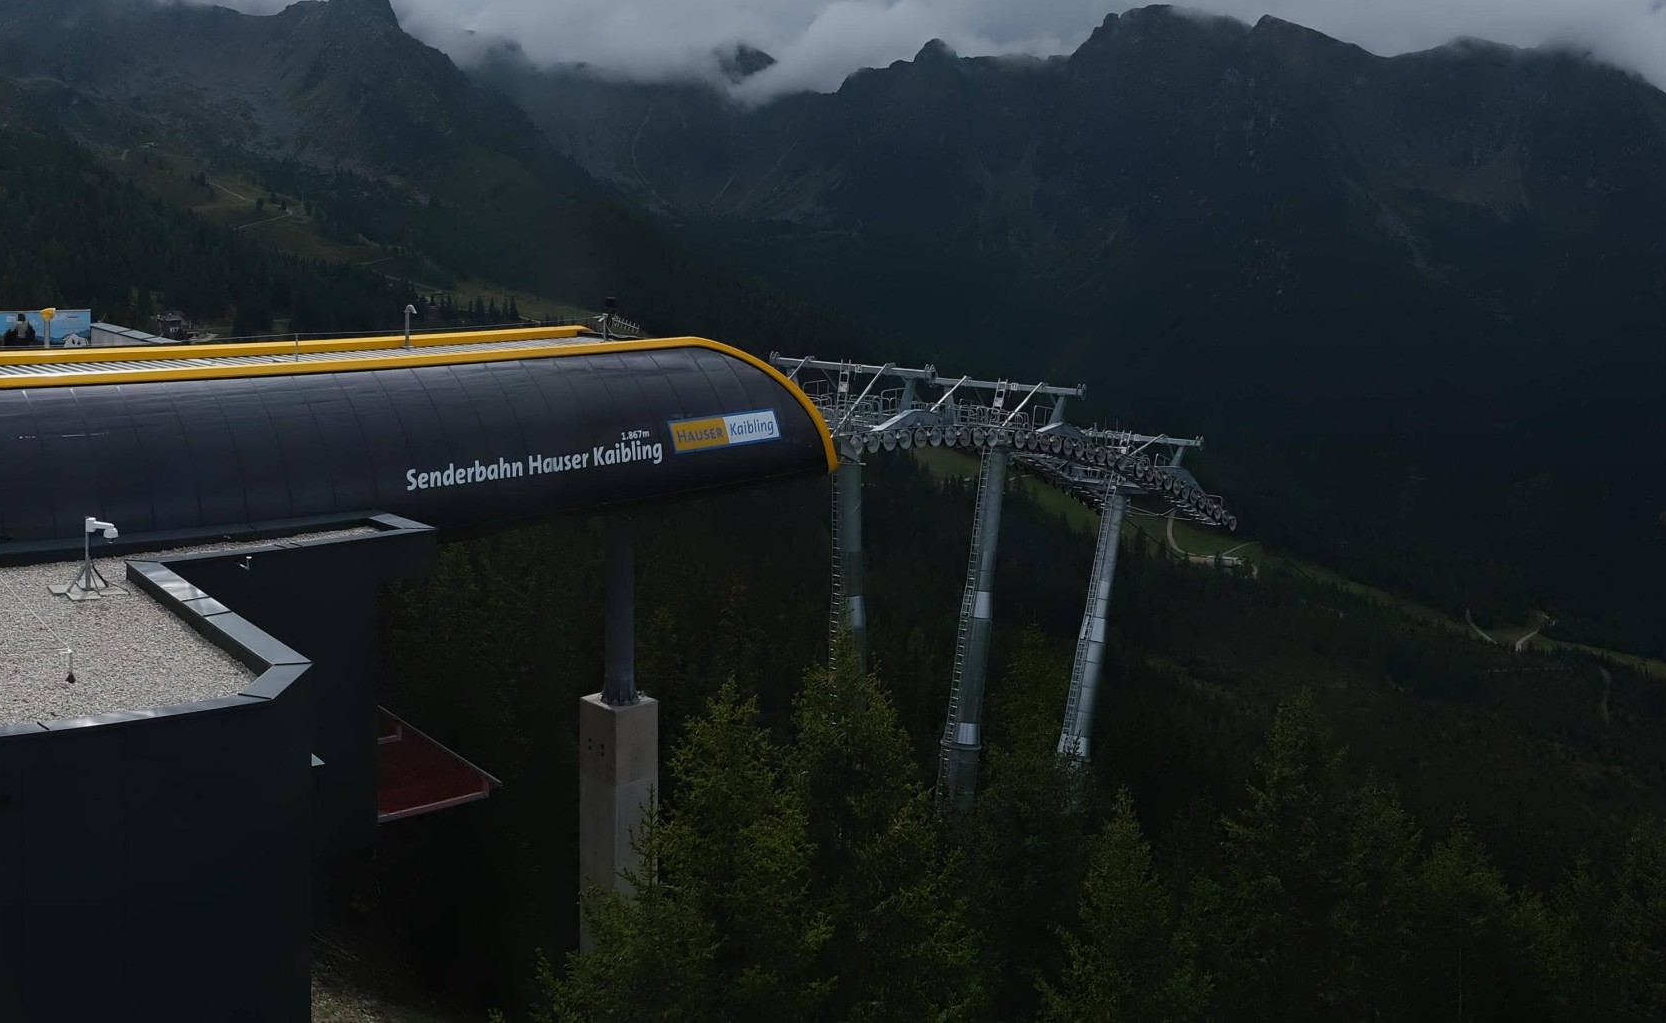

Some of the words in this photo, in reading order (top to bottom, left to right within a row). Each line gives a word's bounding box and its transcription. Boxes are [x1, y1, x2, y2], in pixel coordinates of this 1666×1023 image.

[621, 429, 650, 441] 1.867m
[676, 427, 724, 444] HAUSER
[730, 417, 775, 438] Kaibling
[406, 457, 523, 491] Senderbahn
[528, 451, 589, 476] Hauser
[593, 440, 663, 467] Kaibling
